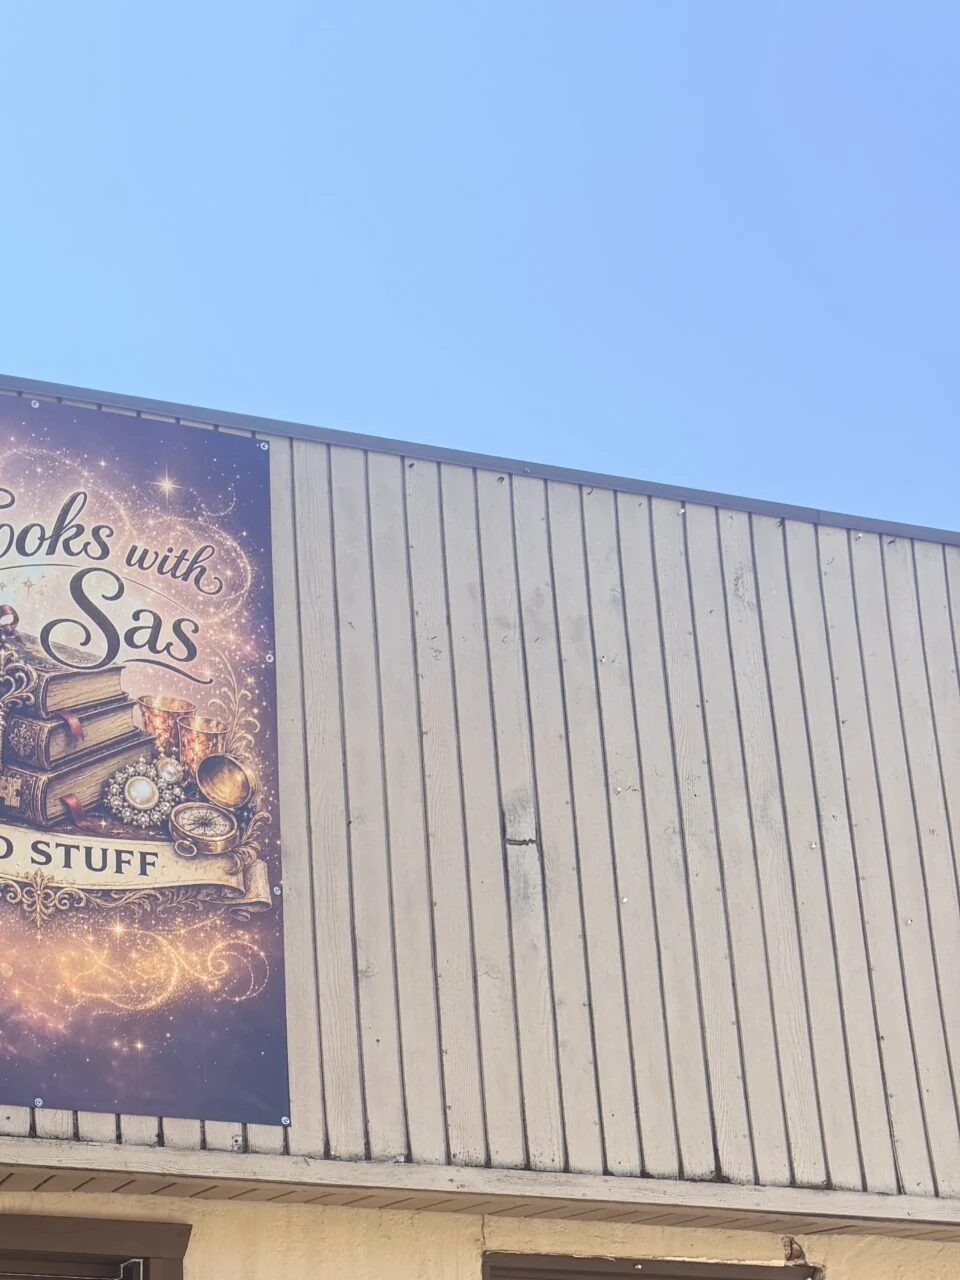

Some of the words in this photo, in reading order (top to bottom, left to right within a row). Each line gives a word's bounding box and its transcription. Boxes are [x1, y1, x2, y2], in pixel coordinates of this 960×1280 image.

[125, 543, 224, 596] with
[40, 567, 202, 672] Sas
[30, 840, 160, 877] STUFF
